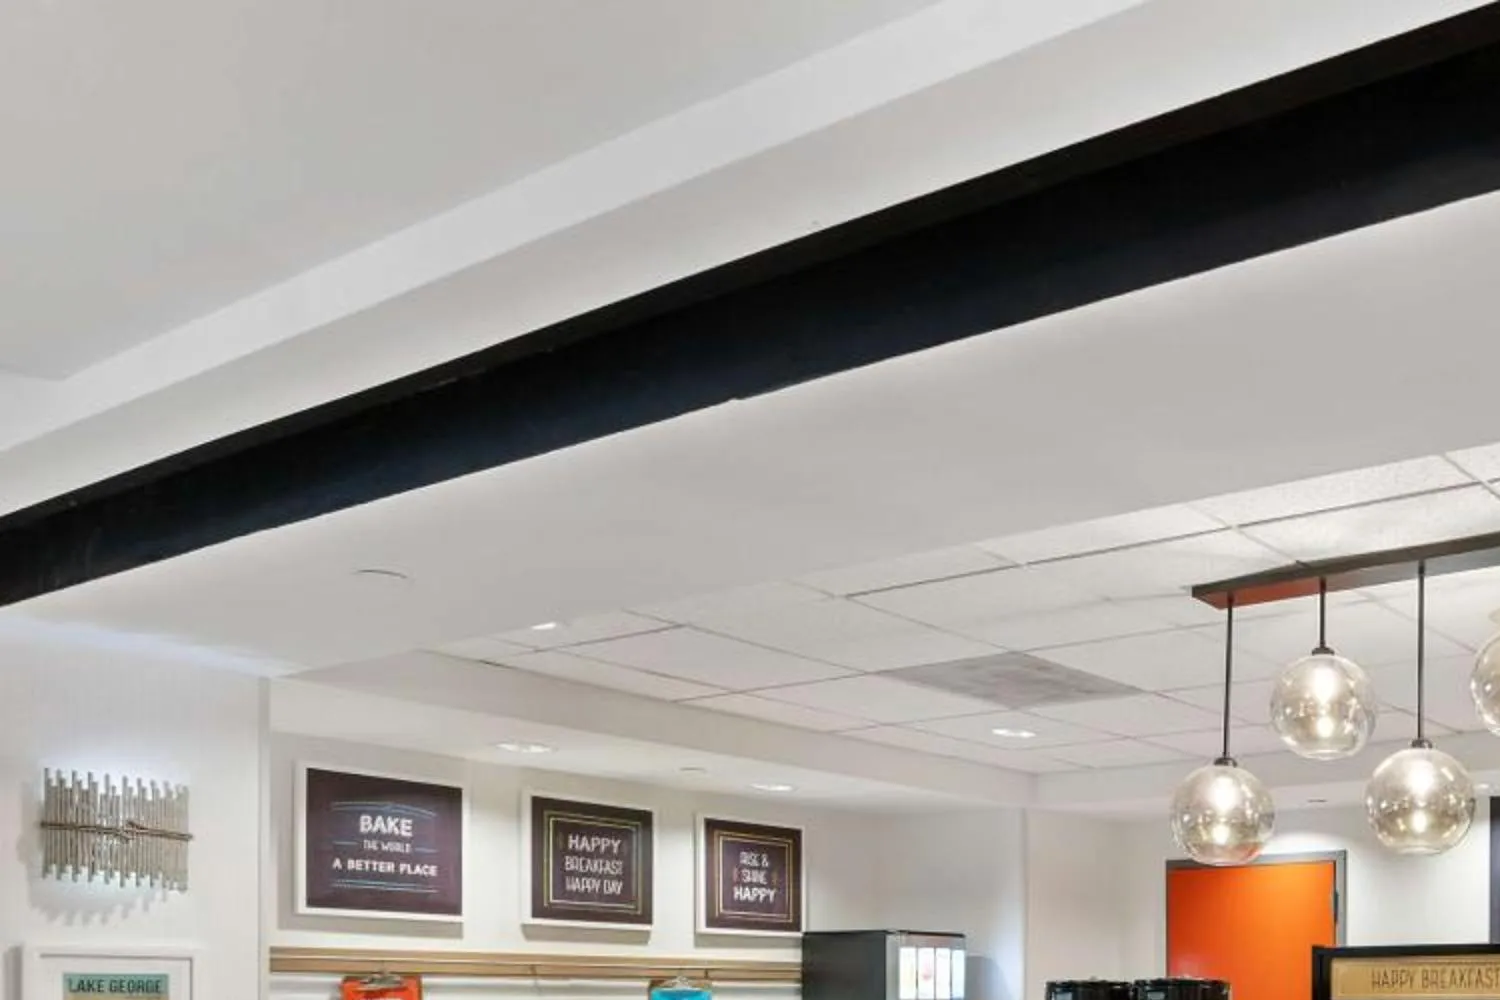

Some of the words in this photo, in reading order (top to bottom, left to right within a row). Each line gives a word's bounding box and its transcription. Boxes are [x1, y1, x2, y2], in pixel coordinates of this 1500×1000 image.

[358, 814, 413, 837] BAKE
[568, 834, 622, 854] HAPPY
[332, 857, 342, 870] A
[347, 858, 394, 874] BETTER
[399, 863, 438, 877] PLACE
[564, 855, 623, 875] BREAKFAST
[565, 875, 601, 894] HAPPY
[603, 879, 623, 896] DAY
[732, 886, 777, 904] HAPPY
[68, 977, 105, 993] LAKE
[109, 978, 162, 994] GEORGE
[1371, 967, 1415, 990] HAPPY
